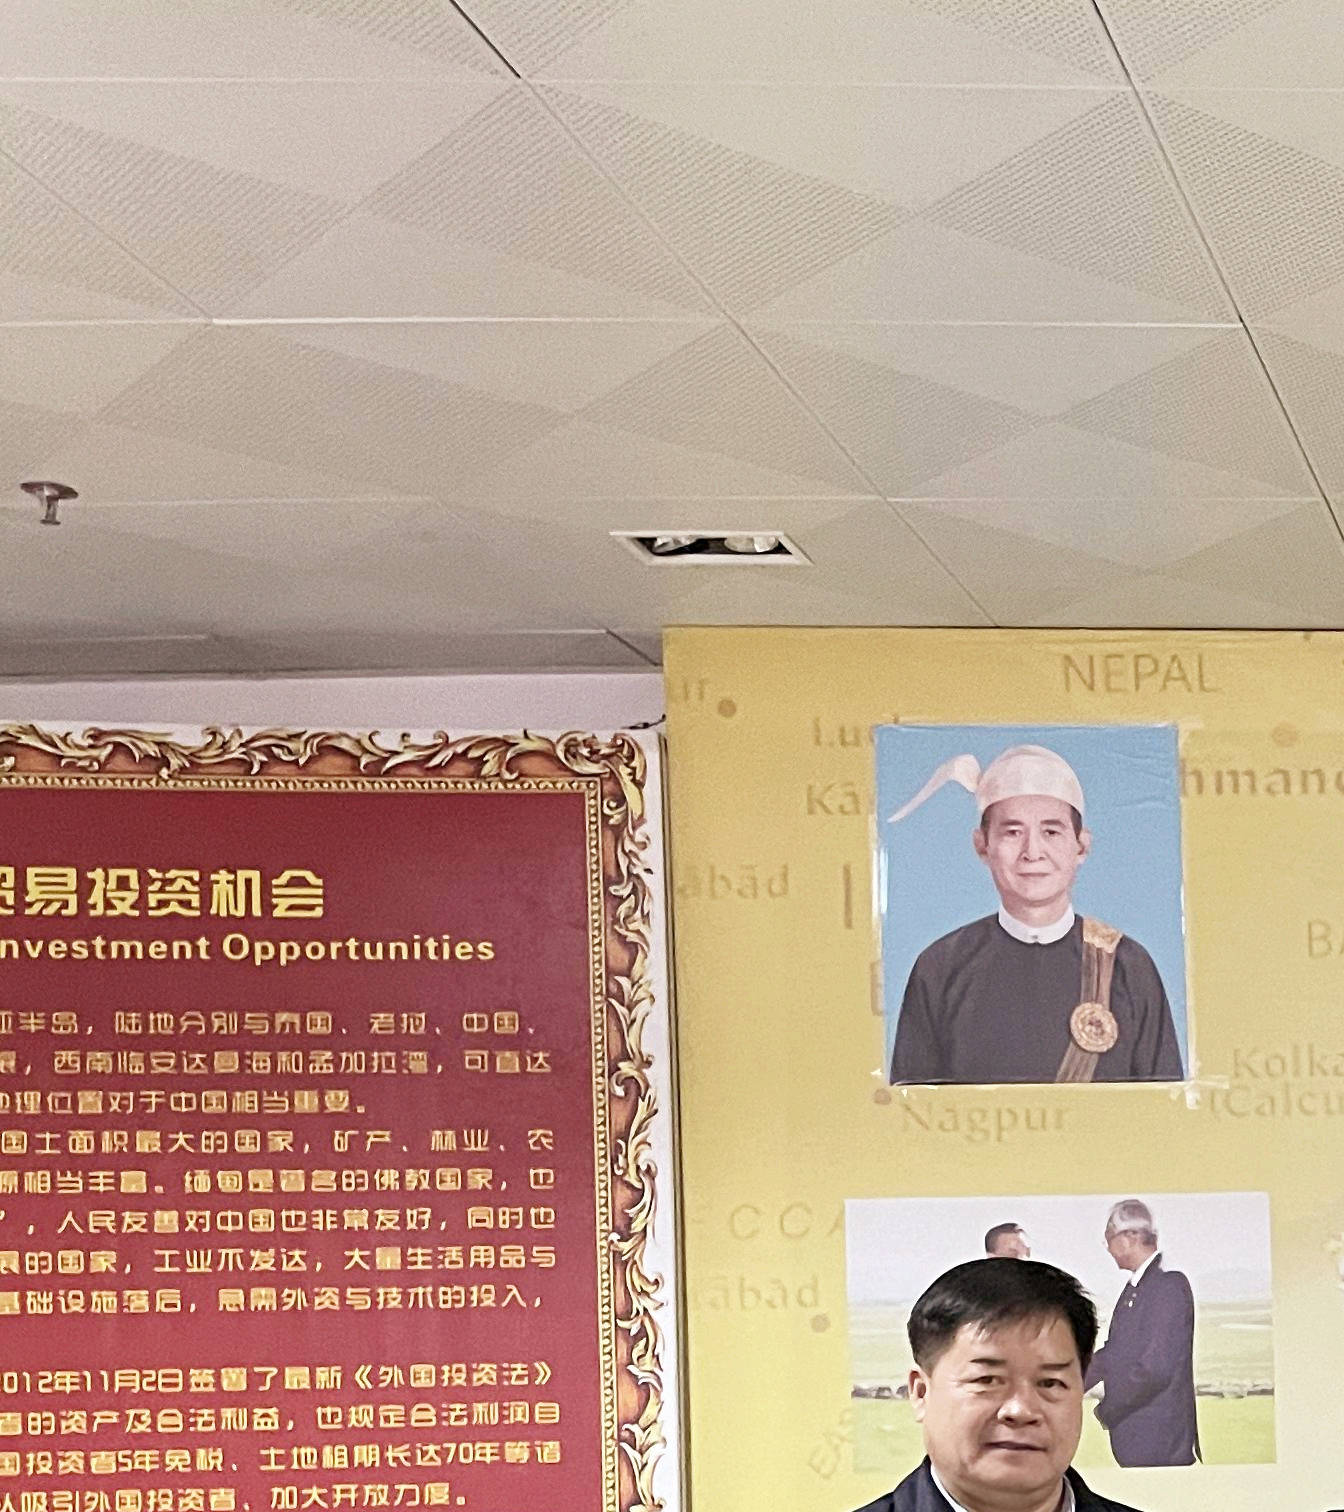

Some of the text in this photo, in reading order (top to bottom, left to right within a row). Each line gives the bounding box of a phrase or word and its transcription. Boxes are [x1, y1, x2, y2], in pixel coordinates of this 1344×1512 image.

[1062, 652, 1222, 693] NEPAL
[0, 866, 325, 918] 易投资机会
[221, 933, 496, 967] Opportunities
